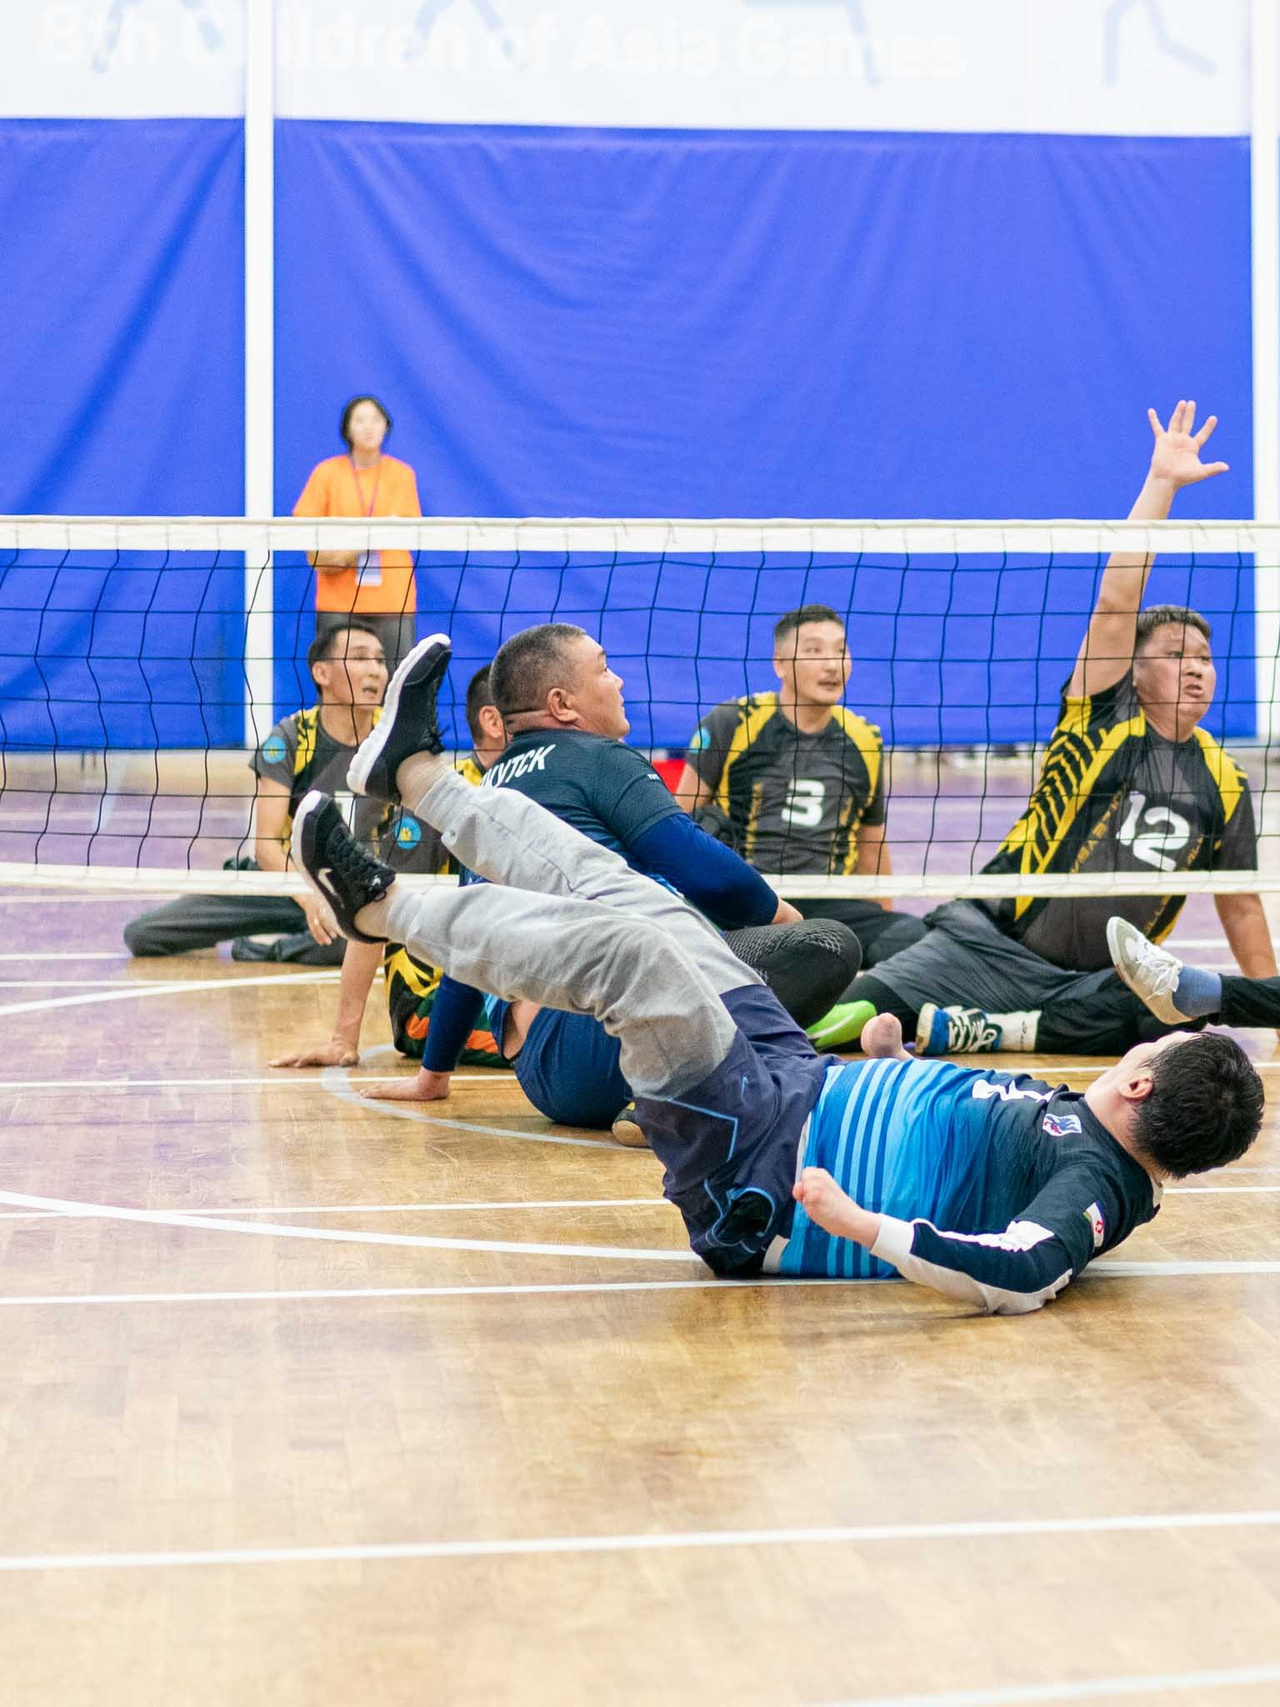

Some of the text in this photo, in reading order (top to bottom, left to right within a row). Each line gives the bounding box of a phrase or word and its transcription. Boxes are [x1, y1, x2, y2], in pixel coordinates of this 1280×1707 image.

[569, 13, 720, 76] Asia
[736, 15, 968, 80] Games
[781, 779, 825, 827] 3
[1116, 790, 1190, 872] 12
